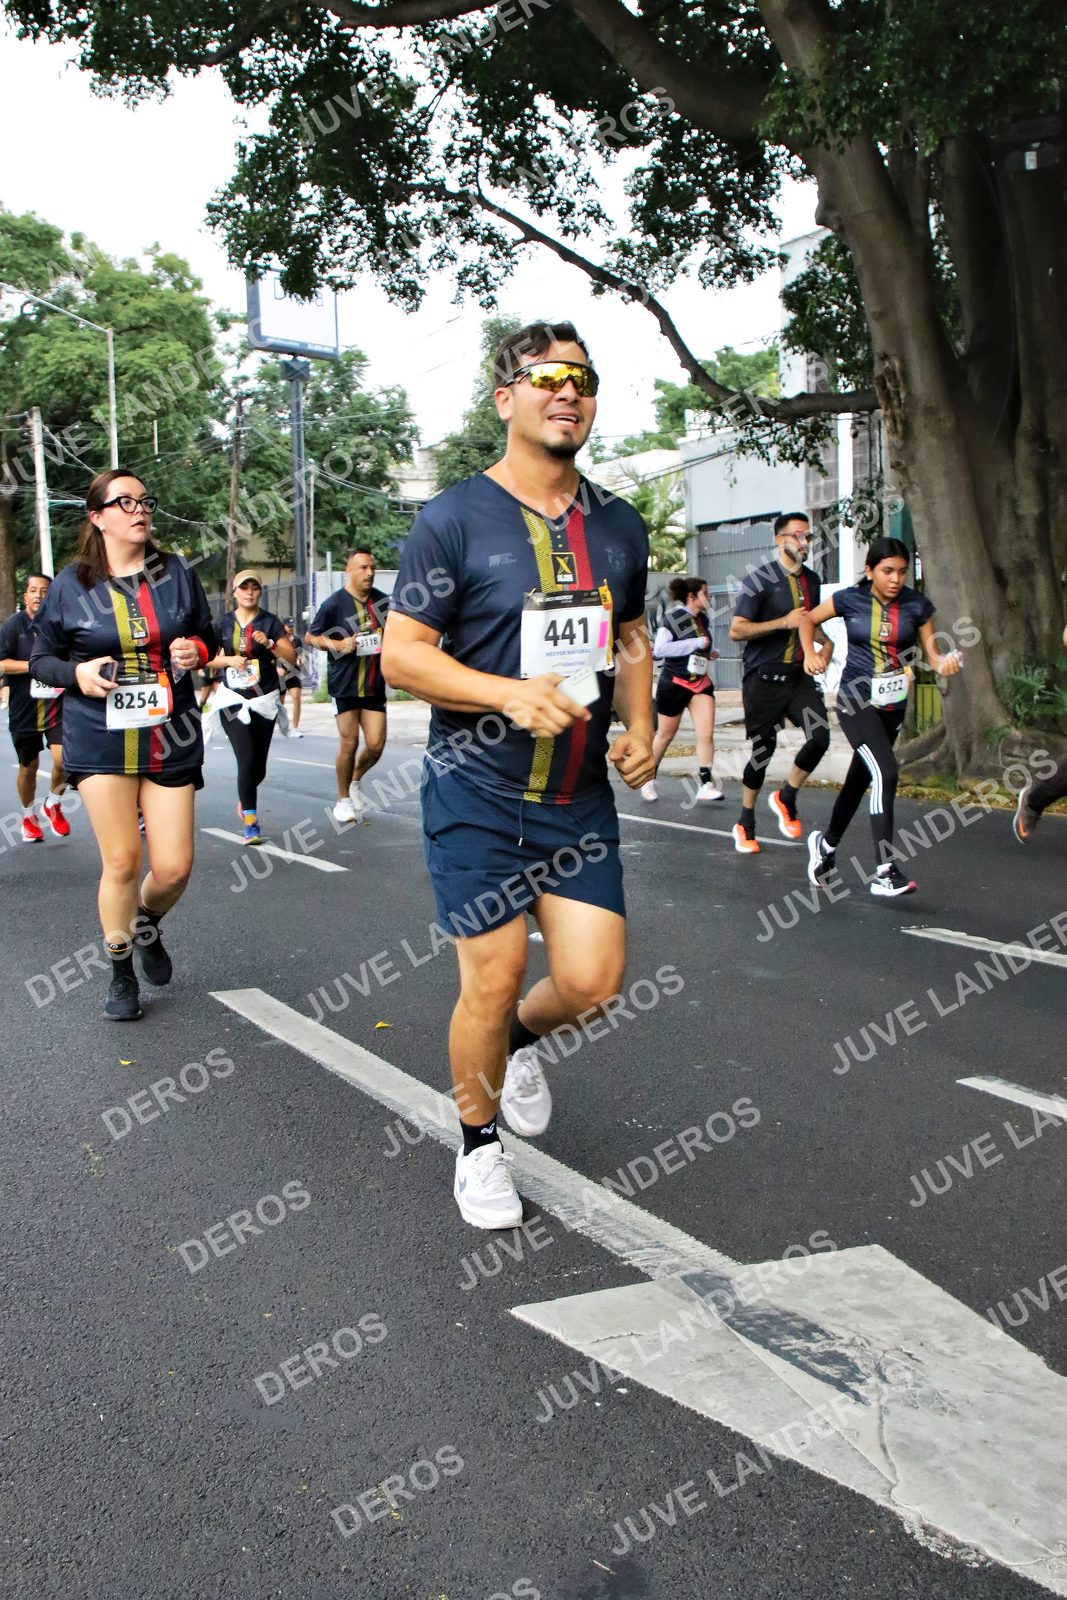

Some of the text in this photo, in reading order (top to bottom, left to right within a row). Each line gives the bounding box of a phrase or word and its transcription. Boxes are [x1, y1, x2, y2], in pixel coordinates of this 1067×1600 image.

[544, 617, 588, 646] 441
[878, 680, 903, 694] 6522
[114, 690, 158, 710] 8254
